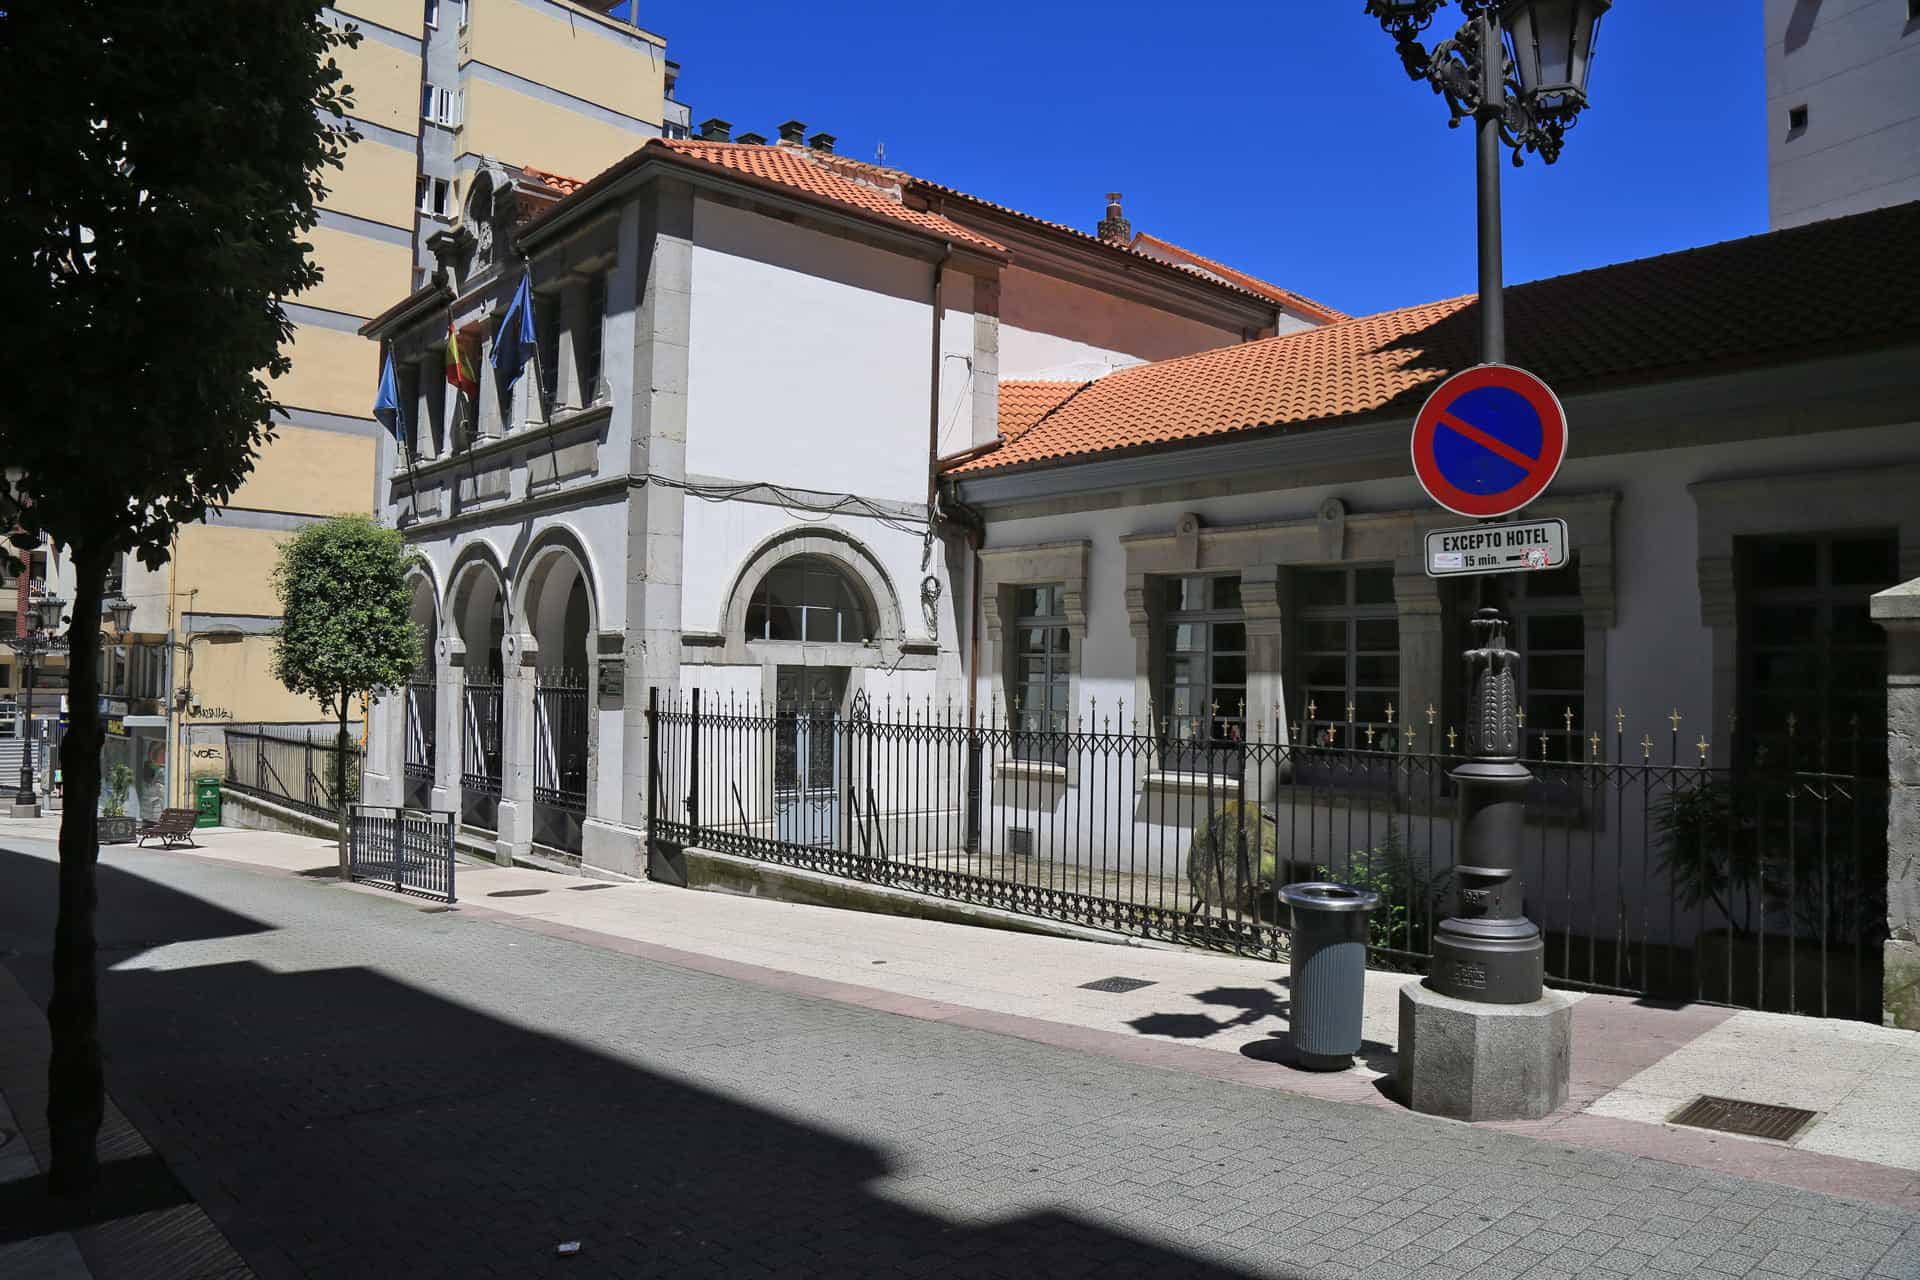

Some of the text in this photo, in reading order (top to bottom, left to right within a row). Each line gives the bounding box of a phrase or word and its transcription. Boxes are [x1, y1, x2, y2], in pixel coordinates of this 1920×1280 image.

[1443, 528, 1549, 551] EXCEPTO HOTEL
[1464, 555, 1475, 567] 15
[1478, 554, 1500, 566] min.
